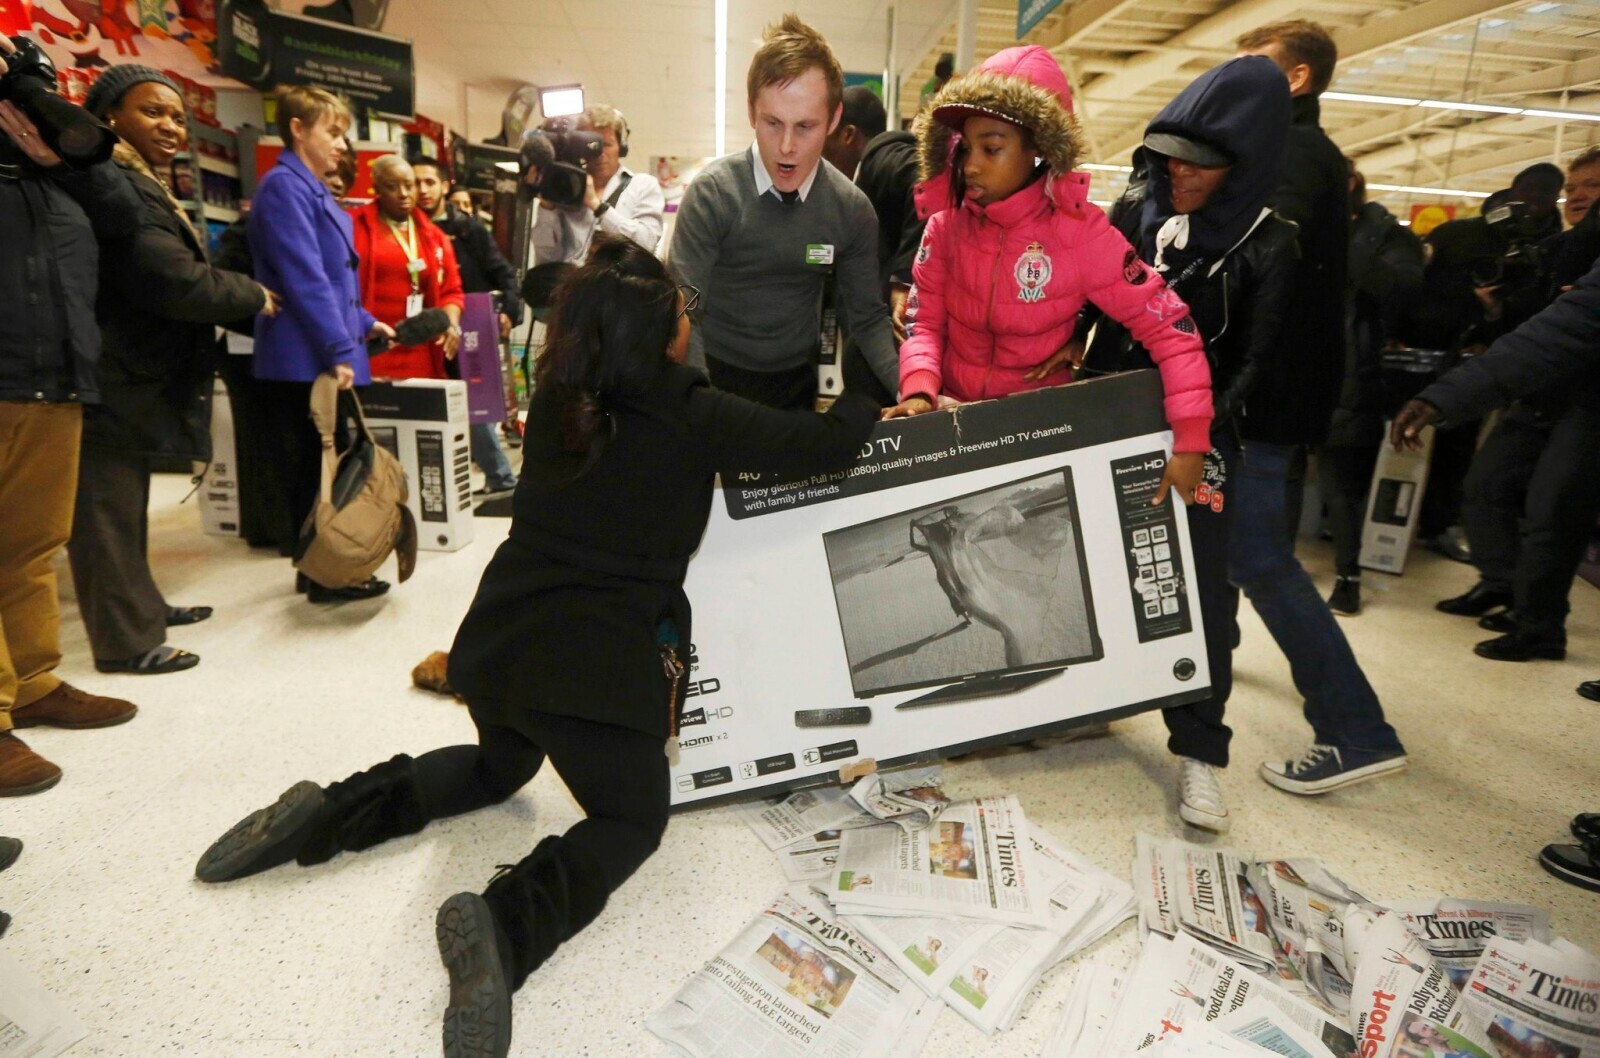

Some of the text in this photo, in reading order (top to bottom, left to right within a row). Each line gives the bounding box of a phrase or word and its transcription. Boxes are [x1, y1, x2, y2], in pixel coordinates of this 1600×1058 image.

[876, 435, 902, 454] TV
[742, 487, 769, 500] Enjoy
[771, 479, 808, 494] glorious
[810, 474, 828, 486] Full
[846, 462, 881, 478] (1080p)
[882, 458, 912, 472] quality
[915, 452, 948, 464] images
[950, 447, 956, 456] &
[958, 440, 998, 454] Freeview
[1000, 434, 1015, 445] HD
[1017, 432, 1030, 442] TV
[1032, 424, 1072, 440] channels
[1144, 459, 1165, 471] HD
[744, 485, 840, 511] with family & friends
[1194, 483, 1224, 513] 68
[685, 678, 720, 698] ED
[706, 706, 734, 721] HD
[679, 735, 713, 748] HDMI
[832, 745, 854, 755] Mountable
[996, 831, 1017, 888] Times
[1194, 868, 1217, 915] Times
[1416, 914, 1497, 940] Times
[1438, 909, 1458, 918] Brent
[1467, 909, 1493, 918] Kilburn
[806, 912, 876, 964] Times
[1218, 975, 1231, 1000] deal
[1226, 966, 1235, 976] as
[1526, 968, 1600, 1013] Times
[704, 962, 812, 1044] into failing A&E targets
[772, 996, 820, 1034] launched
[1409, 988, 1436, 1014] Jolly
[1356, 1012, 1368, 1041] Times
[1360, 990, 1397, 1058] sport
